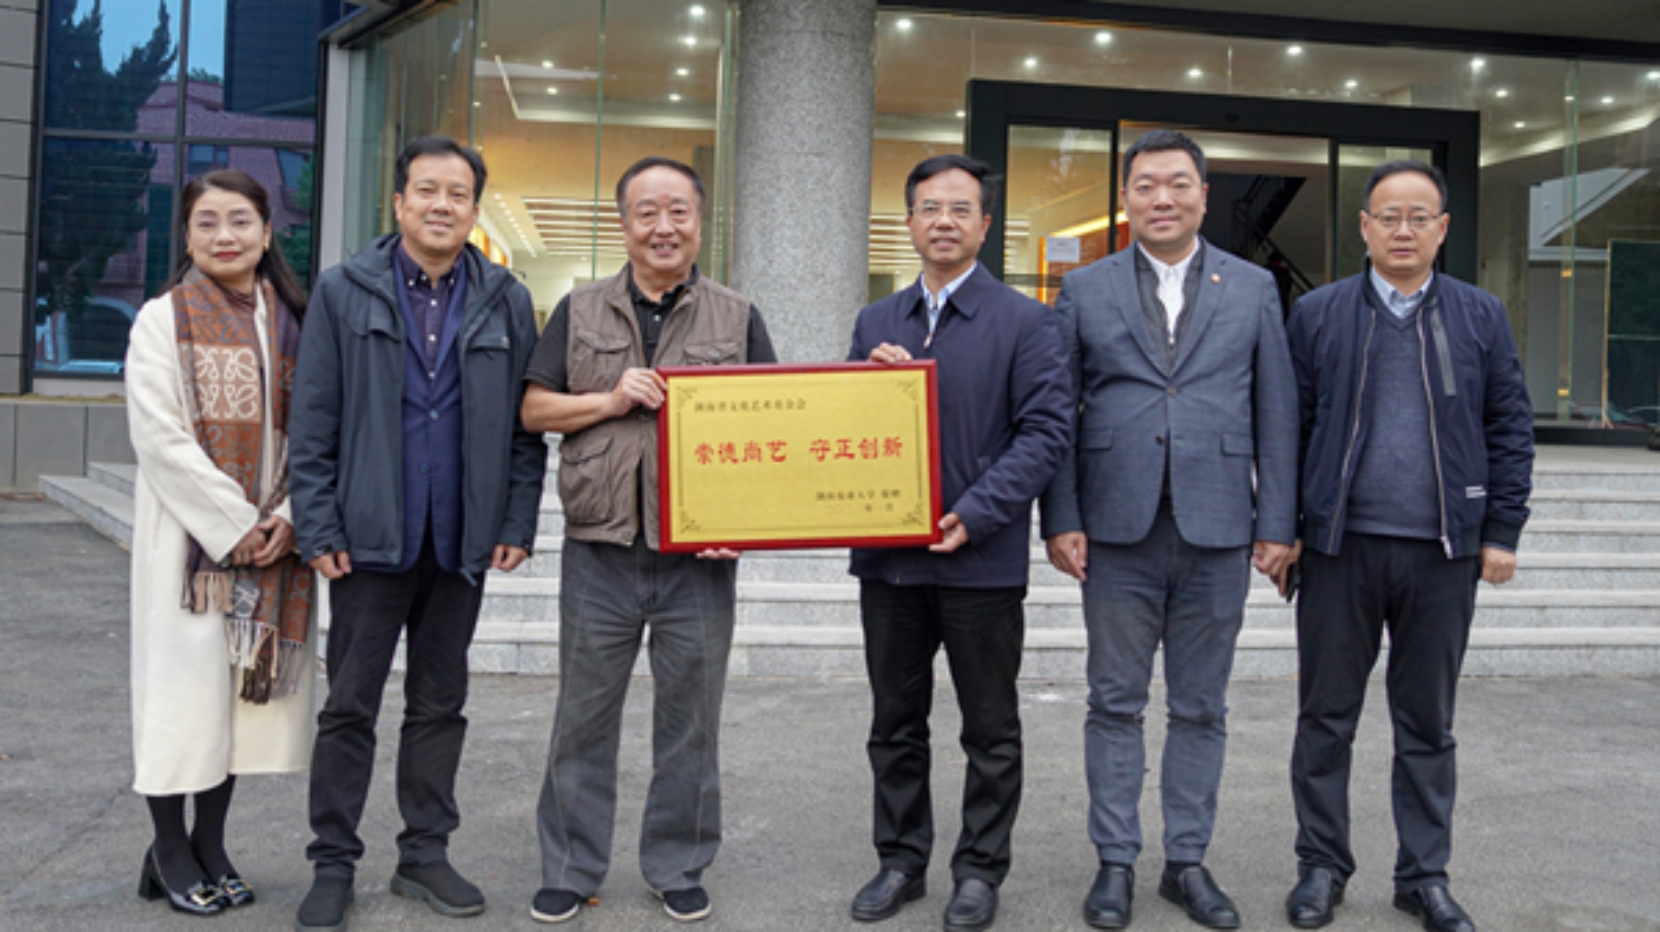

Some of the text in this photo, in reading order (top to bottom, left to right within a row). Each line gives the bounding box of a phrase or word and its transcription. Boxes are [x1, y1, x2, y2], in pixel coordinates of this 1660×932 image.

[694, 436, 904, 465] 崇德尚艺 守正创新
